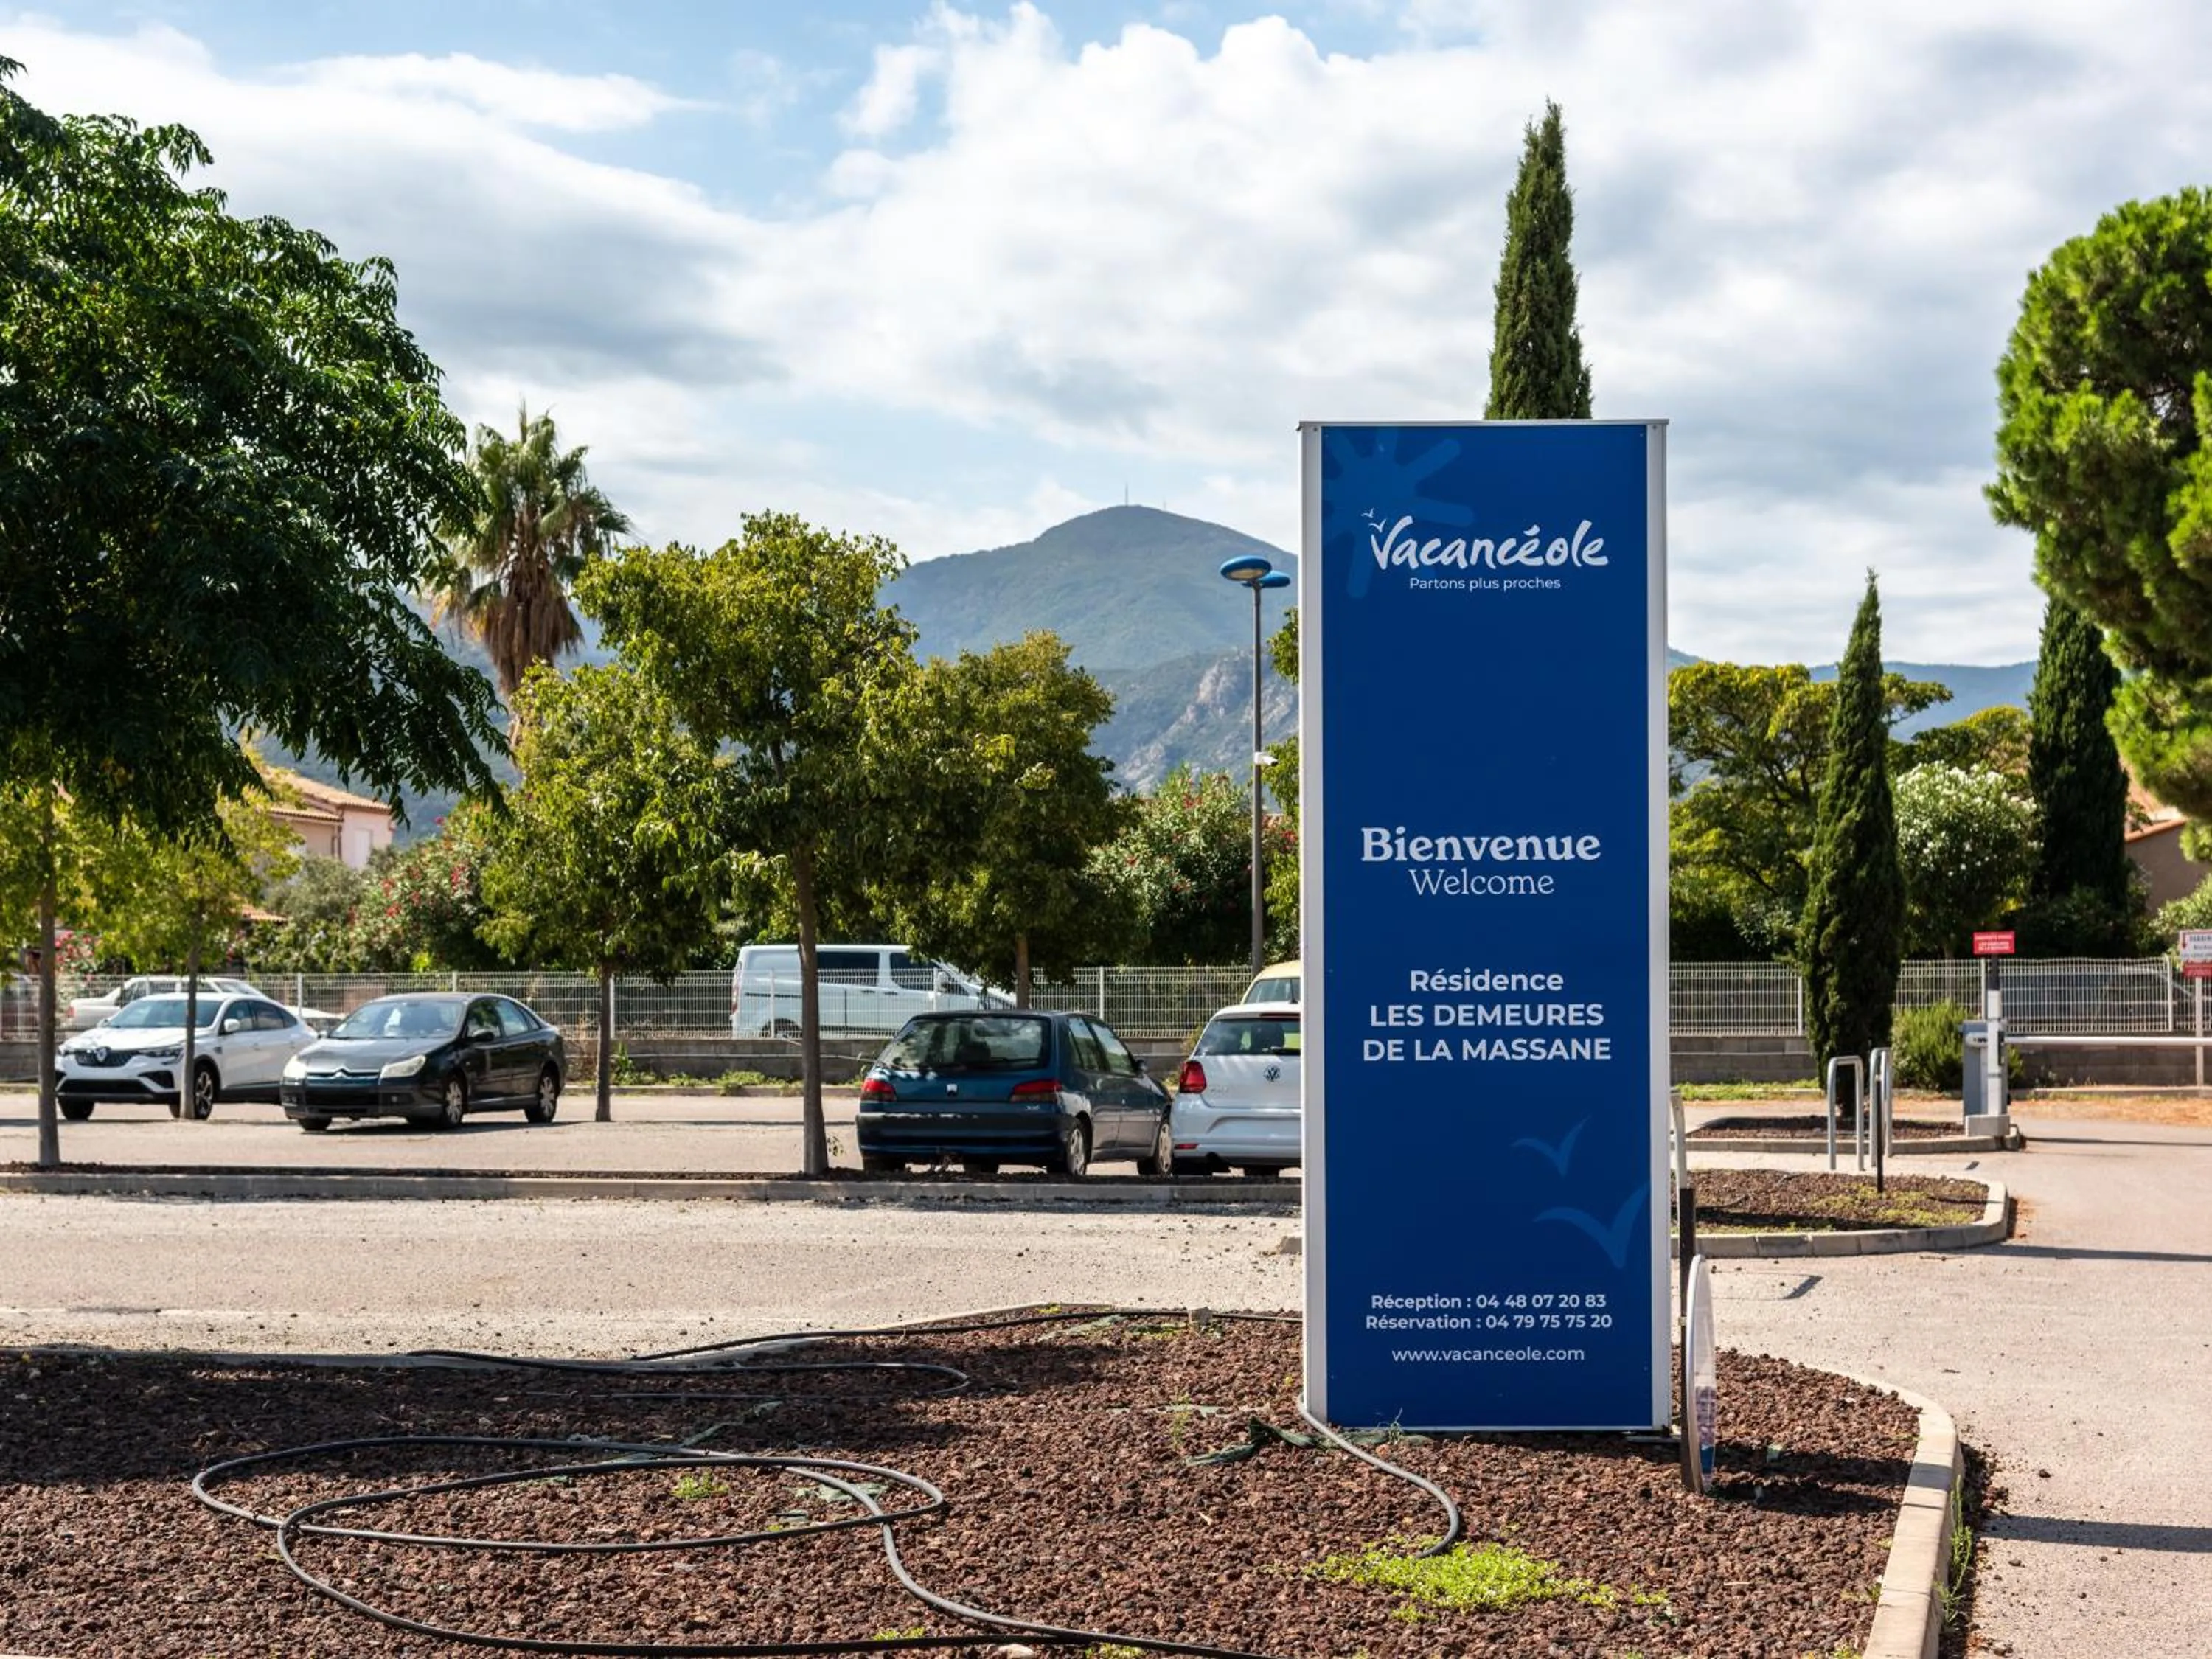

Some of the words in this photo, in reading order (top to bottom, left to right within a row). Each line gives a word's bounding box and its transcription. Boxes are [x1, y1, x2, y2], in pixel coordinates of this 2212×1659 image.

[1371, 515, 1609, 570] Vacancéole
[1409, 577, 1465, 589] Partons
[1470, 577, 1499, 592] plus
[1503, 577, 1561, 592] proches
[1361, 826, 1601, 862] Bienvenue
[1408, 868, 1554, 895] Welcome
[1410, 967, 1564, 992] Résidence
[1371, 1004, 1424, 1027] LES
[1434, 1004, 1604, 1026] DEMEURES
[1363, 1039, 1405, 1061] DE
[1415, 1039, 1453, 1061] LA
[1462, 1037, 1611, 1061] MASSANE
[1371, 1293, 1461, 1312] Réception
[1476, 1295, 1500, 1308] 04
[1504, 1294, 1527, 1308] 48
[1531, 1294, 1554, 1307] 07
[1559, 1294, 1581, 1307] 20
[1585, 1294, 1607, 1307] 83
[1366, 1314, 1471, 1329] Réservation
[1486, 1315, 1509, 1329] 04
[1513, 1315, 1534, 1328] 79
[1540, 1315, 1560, 1328] 75
[1565, 1315, 1586, 1328] 75
[1590, 1315, 1612, 1328] 20
[1391, 1346, 1585, 1361] www.vacanceole.com
